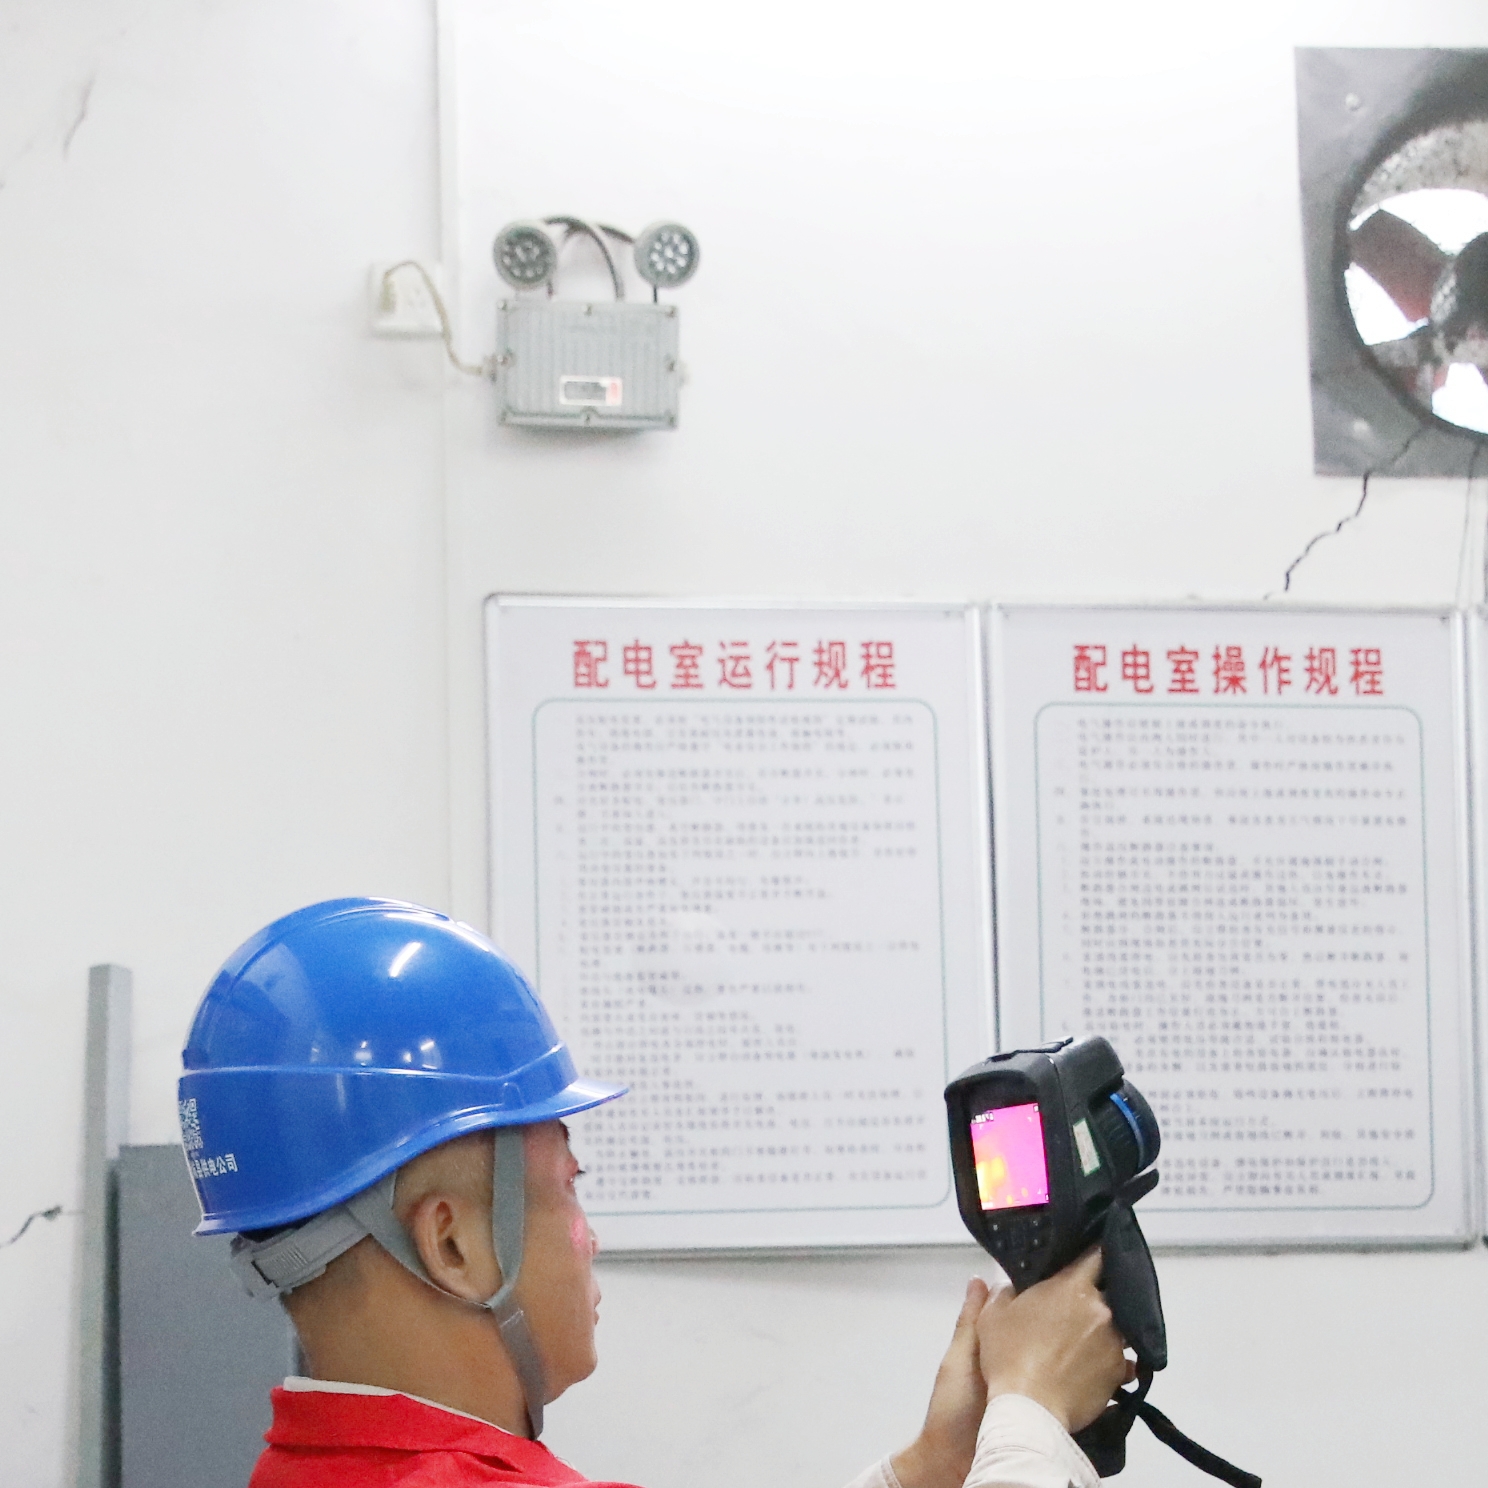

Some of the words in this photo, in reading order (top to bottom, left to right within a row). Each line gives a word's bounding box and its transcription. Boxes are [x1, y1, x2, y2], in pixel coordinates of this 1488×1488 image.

[572, 638, 898, 690] 配电室运行规程
[1072, 643, 1386, 697] 配电室操作规程
